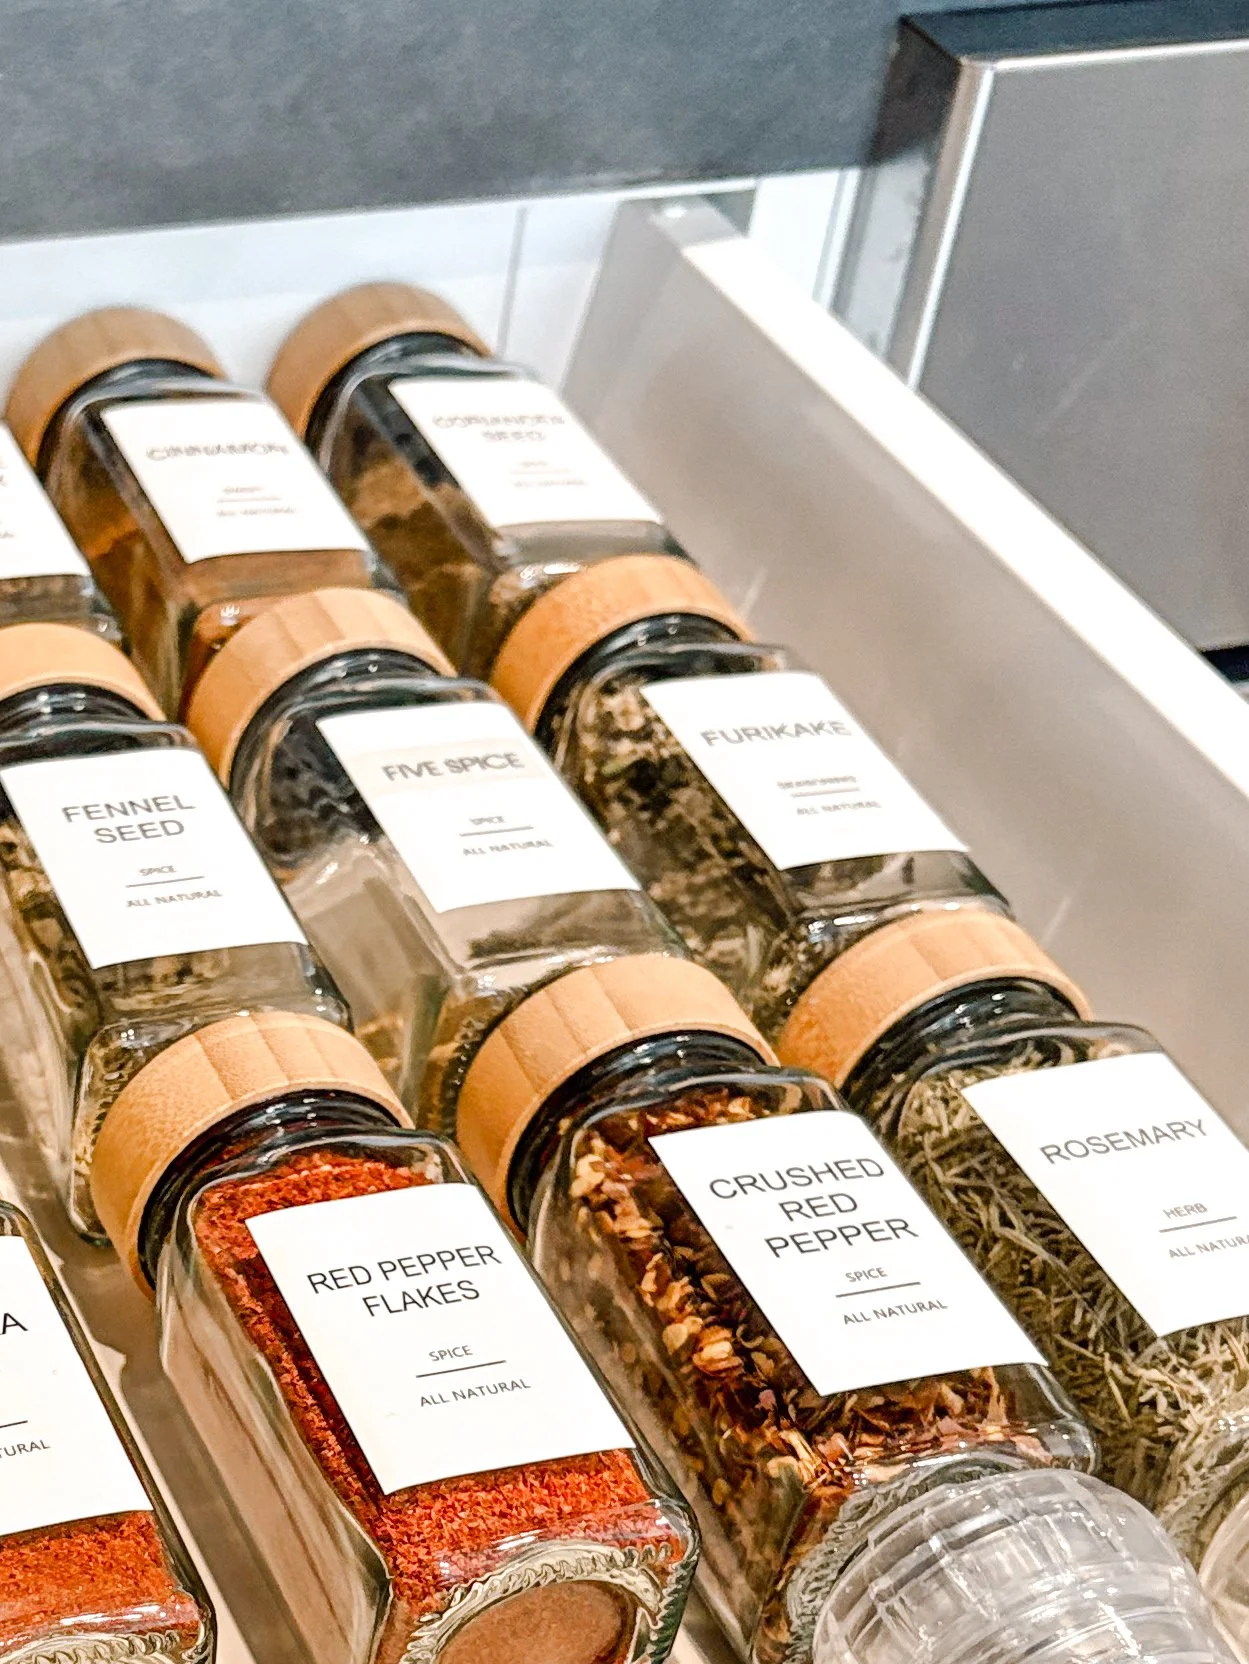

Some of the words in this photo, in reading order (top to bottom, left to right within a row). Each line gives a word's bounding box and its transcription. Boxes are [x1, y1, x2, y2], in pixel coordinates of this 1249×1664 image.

[700, 719, 852, 747] FURIKAKE
[381, 760, 443, 782] FIVE
[443, 752, 526, 775] SPICE
[61, 794, 196, 823] FENNEL
[93, 819, 185, 844] SEED
[462, 845, 487, 856] ALL
[489, 838, 554, 853] NATURAL
[139, 865, 177, 877] SPICE
[125, 897, 152, 908] ALL
[154, 889, 224, 906] NATURAL
[1040, 1119, 1208, 1165] ROSEMARY
[709, 1158, 885, 1200] CRUSHED
[779, 1192, 858, 1222] RED
[1162, 1202, 1208, 1219] HERB
[764, 1218, 920, 1259] PEPPER
[1168, 1247, 1196, 1259] ALL
[307, 1265, 373, 1294] RED
[376, 1245, 503, 1281] PEPPER
[845, 1267, 888, 1283] SPICE
[362, 1279, 481, 1317] FLAKES
[843, 1313, 871, 1326] ALL
[873, 1299, 948, 1320] NATURAL
[428, 1345, 474, 1362] SPICE
[420, 1394, 451, 1408] ALL
[452, 1378, 532, 1402] NATURAL
